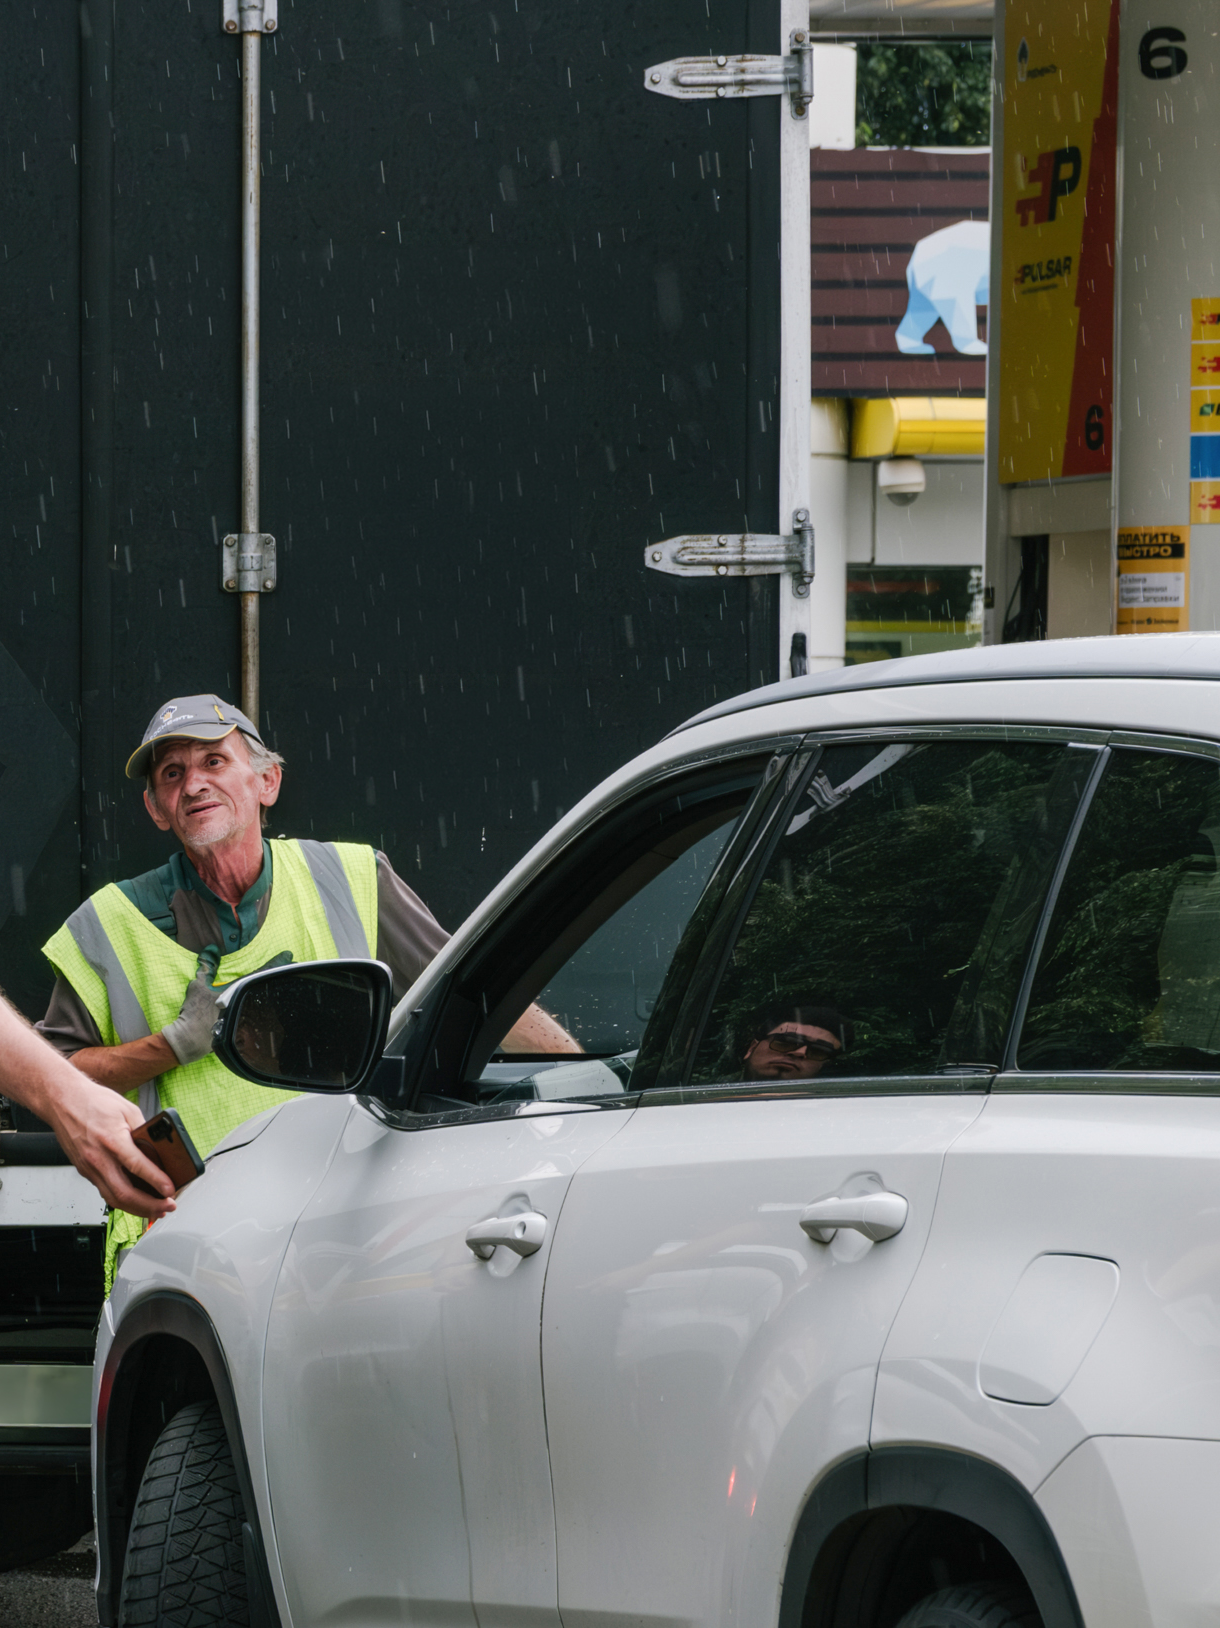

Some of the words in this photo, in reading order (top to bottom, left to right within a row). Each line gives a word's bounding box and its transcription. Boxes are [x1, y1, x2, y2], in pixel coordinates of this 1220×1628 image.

[1138, 26, 1188, 80] 6
[1022, 256, 1072, 284] PULSAR
[1084, 404, 1105, 451] 6
[1118, 532, 1181, 545] ПЛАТИТЬ
